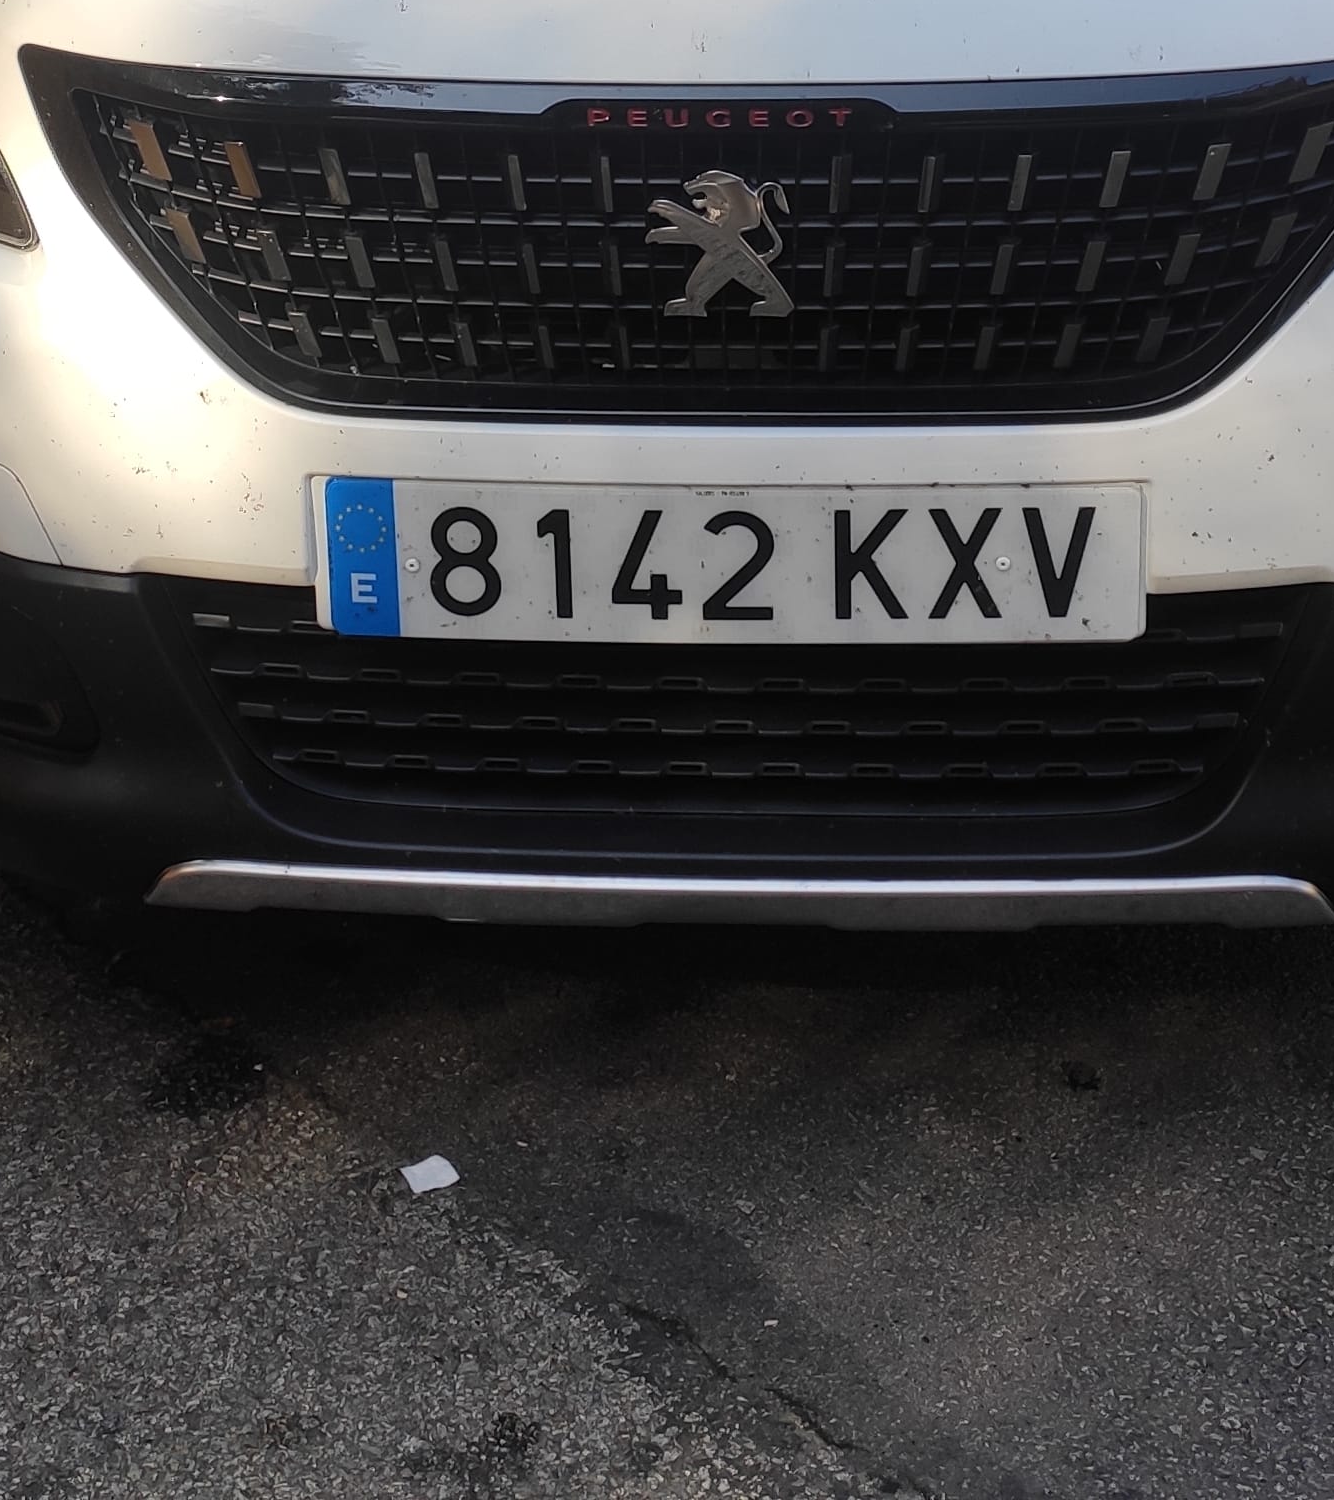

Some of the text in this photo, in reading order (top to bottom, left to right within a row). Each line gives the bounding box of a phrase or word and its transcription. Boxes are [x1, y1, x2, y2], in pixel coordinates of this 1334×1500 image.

[586, 107, 854, 128] PEUGEOT
[429, 506, 1096, 621] 8142 KXV
[350, 572, 378, 604] E
